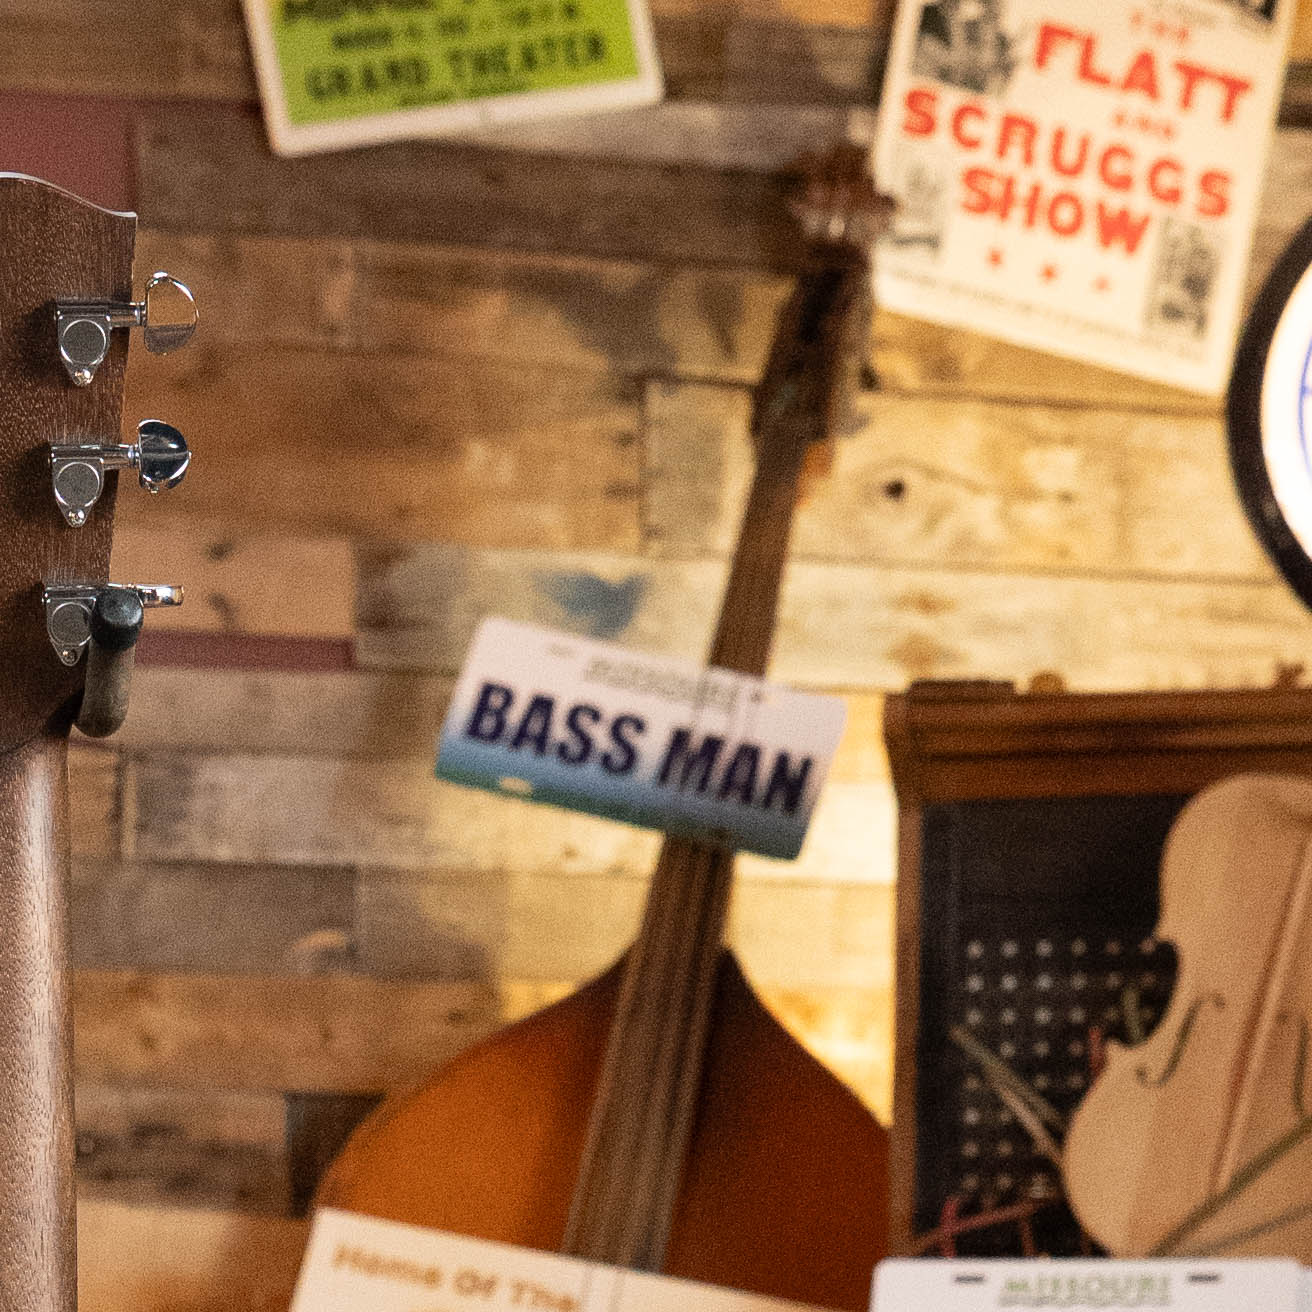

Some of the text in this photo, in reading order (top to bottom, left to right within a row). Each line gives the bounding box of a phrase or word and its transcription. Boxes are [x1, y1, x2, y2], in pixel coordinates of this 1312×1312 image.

[1035, 22, 1253, 123] FLATT
[901, 87, 1232, 218] SCRUGGS
[960, 167, 1151, 255] SHOW
[465, 681, 647, 776] BASS
[657, 724, 814, 815] MAN
